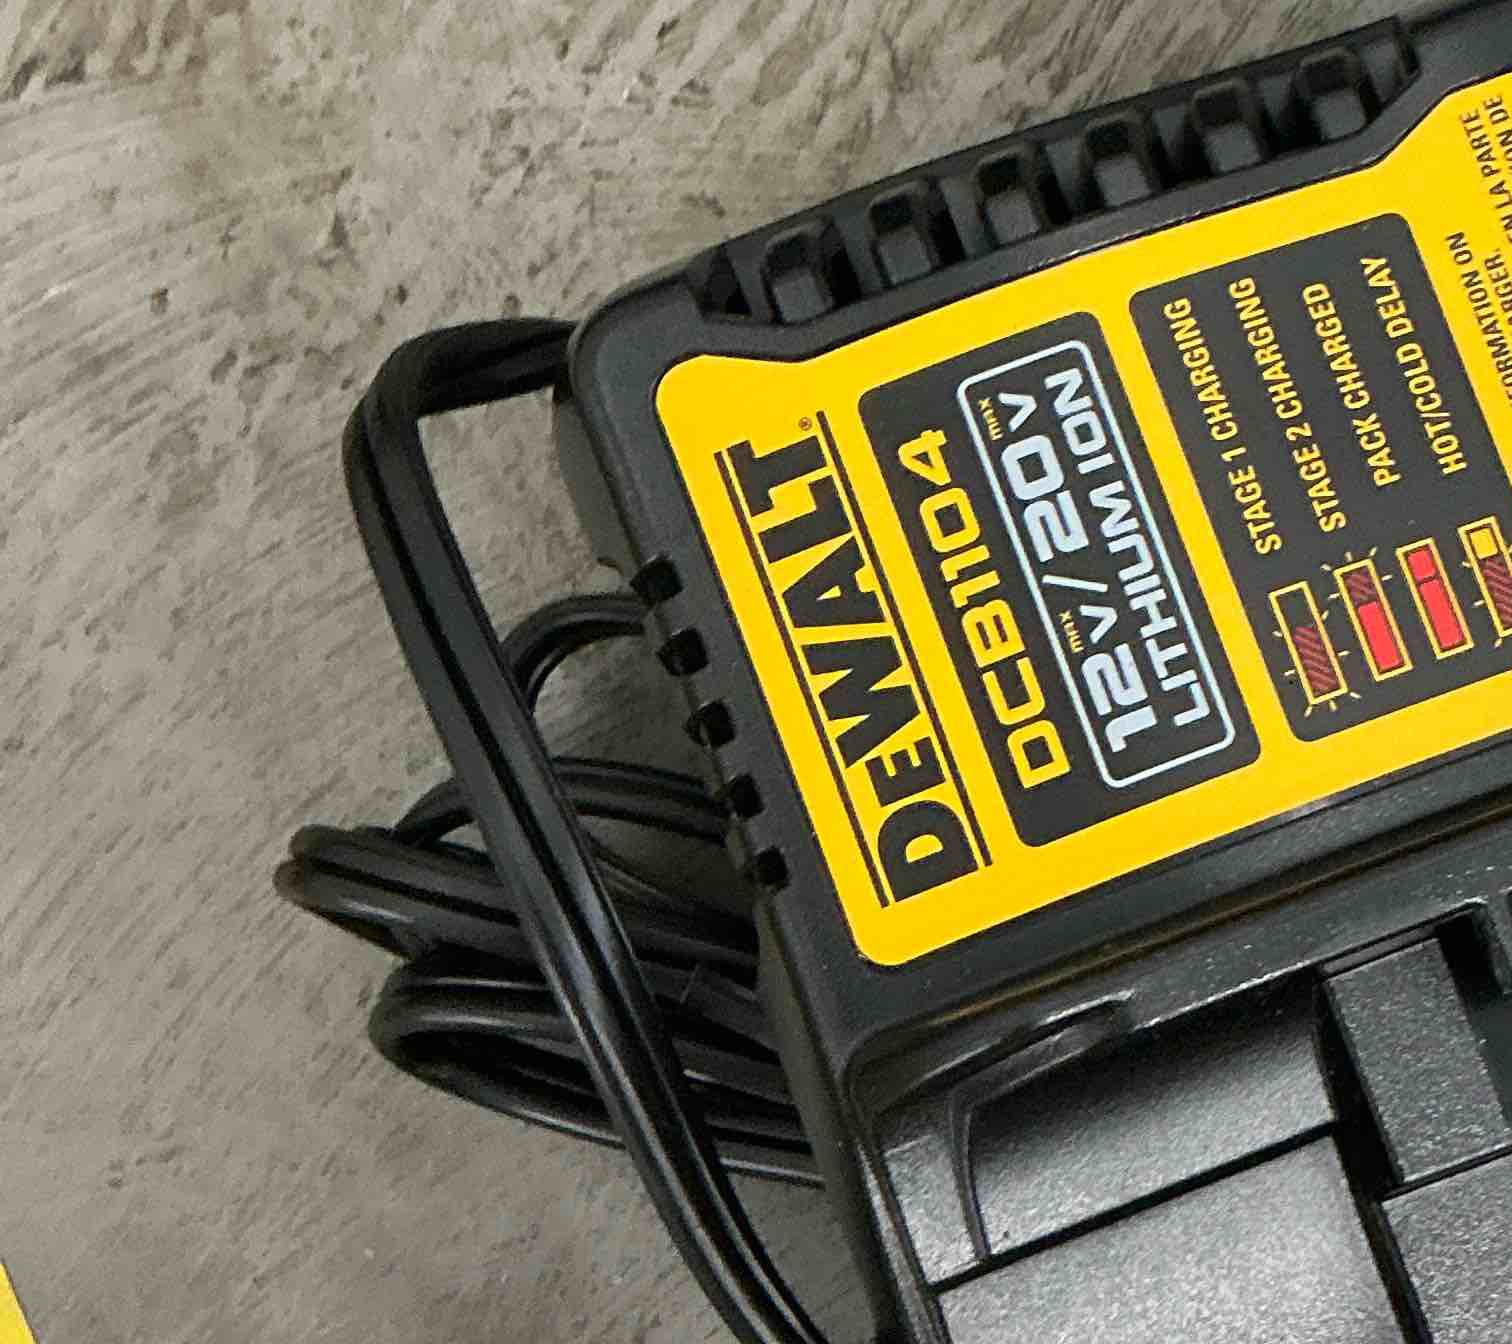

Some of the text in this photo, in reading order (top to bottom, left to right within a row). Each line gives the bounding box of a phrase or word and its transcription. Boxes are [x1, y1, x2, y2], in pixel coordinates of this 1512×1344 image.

[1461, 109, 1501, 178] PARTE
[1482, 95, 1511, 126] DE
[1444, 231, 1474, 266] ON
[1163, 298, 1282, 555] STAGE 1 CHARGING
[1228, 277, 1347, 532] STAGE 2 CHARGING
[1302, 283, 1401, 487] PACK CHARGED
[1359, 257, 1467, 475] HOT/COLD DELAY
[897, 429, 1071, 789] DCB1104
[1044, 367, 1211, 727] LITHIUM ION
